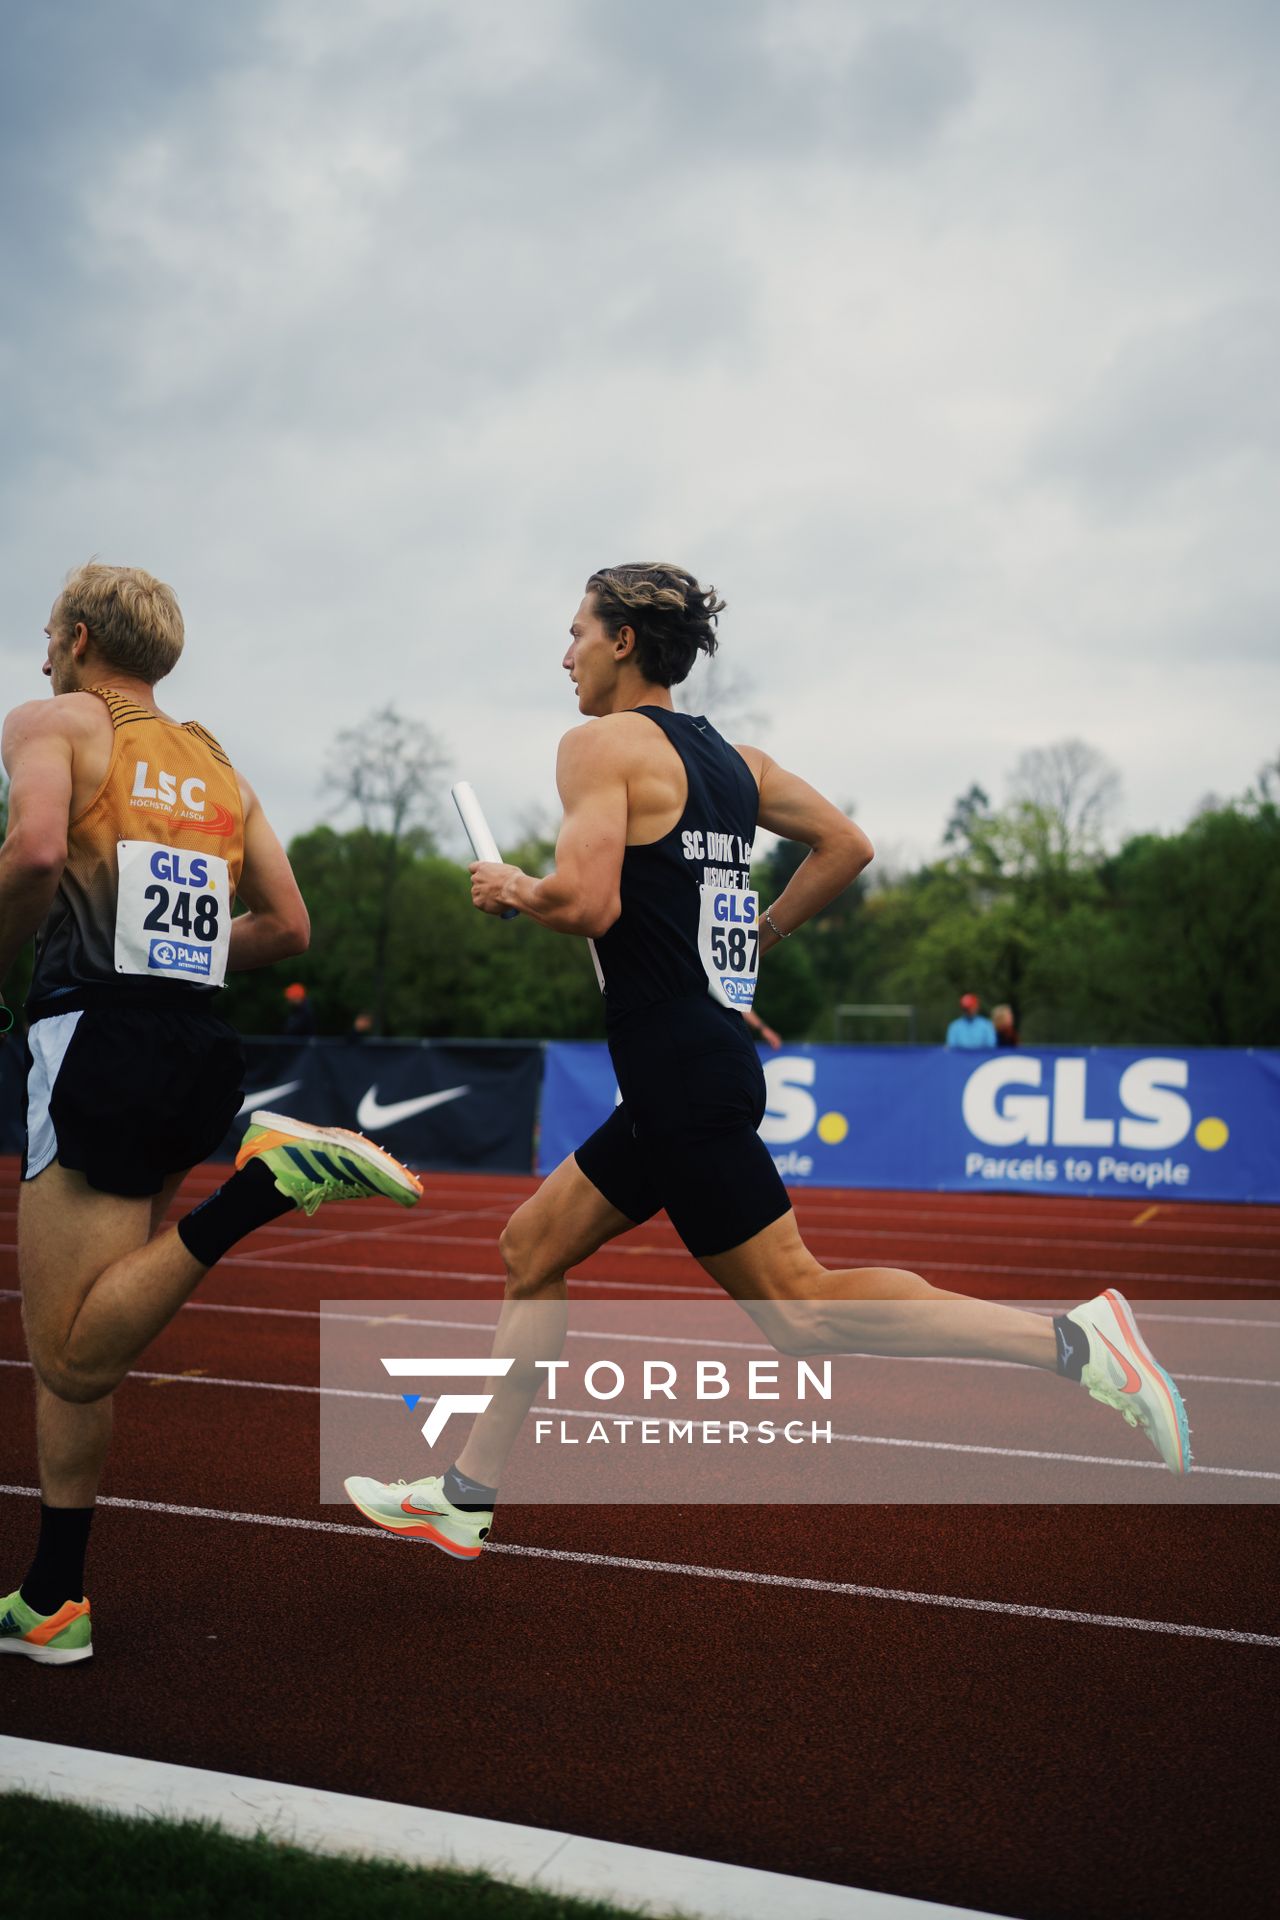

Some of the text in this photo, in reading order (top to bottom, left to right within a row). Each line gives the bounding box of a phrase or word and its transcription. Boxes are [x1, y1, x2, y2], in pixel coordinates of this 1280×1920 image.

[131, 761, 206, 812] LSC
[681, 830, 705, 860] SC
[143, 884, 219, 942] 248
[178, 947, 209, 966] PLAN
[711, 926, 759, 973] 587
[966, 1151, 1190, 1189] Parcels to People
